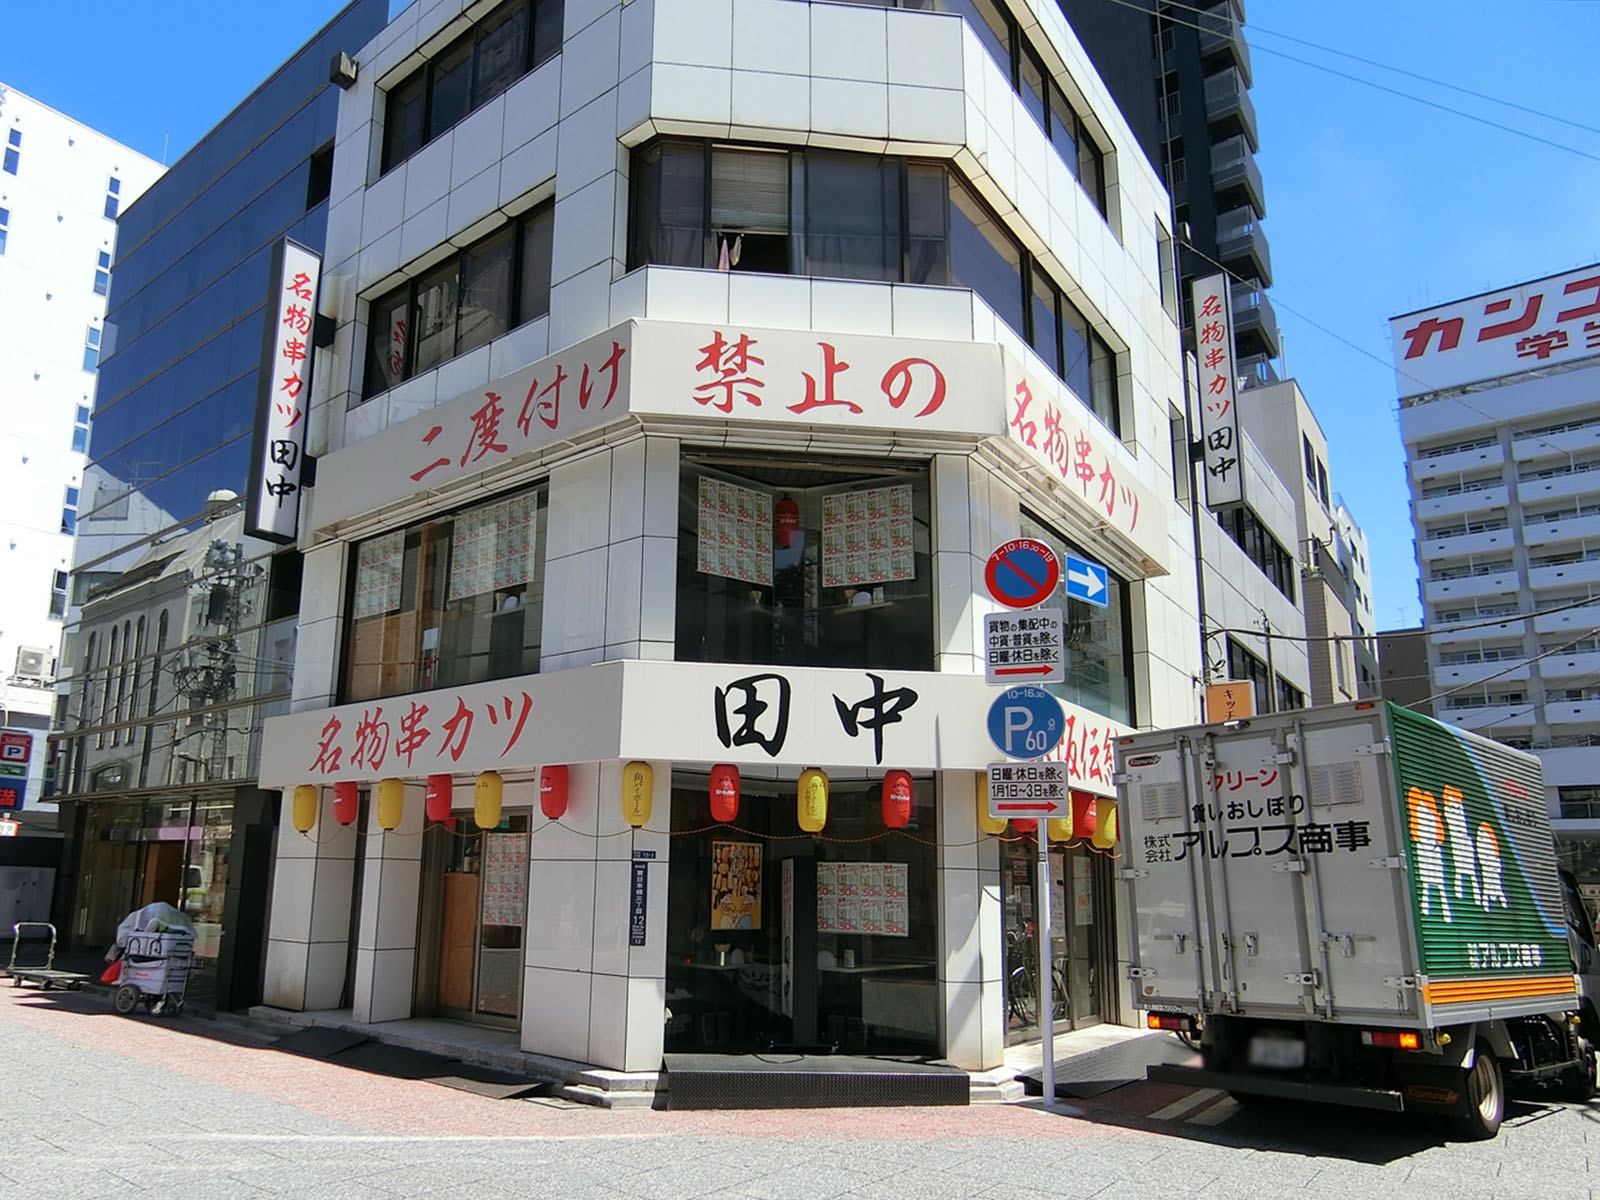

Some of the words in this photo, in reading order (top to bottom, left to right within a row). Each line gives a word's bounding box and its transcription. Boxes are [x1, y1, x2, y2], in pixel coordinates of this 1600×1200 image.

[410, 341, 626, 482] 二度付け
[692, 329, 947, 418] 禁止の
[1010, 376, 1139, 533] 名物串カツ
[988, 617, 1058, 633] 貨物の集配中の
[308, 691, 534, 775] 名物串カツ
[713, 672, 920, 766] 田中
[1004, 706, 1034, 752] P
[1206, 769, 1278, 792] クリーン
[1172, 820, 1372, 862] アルプス商事
